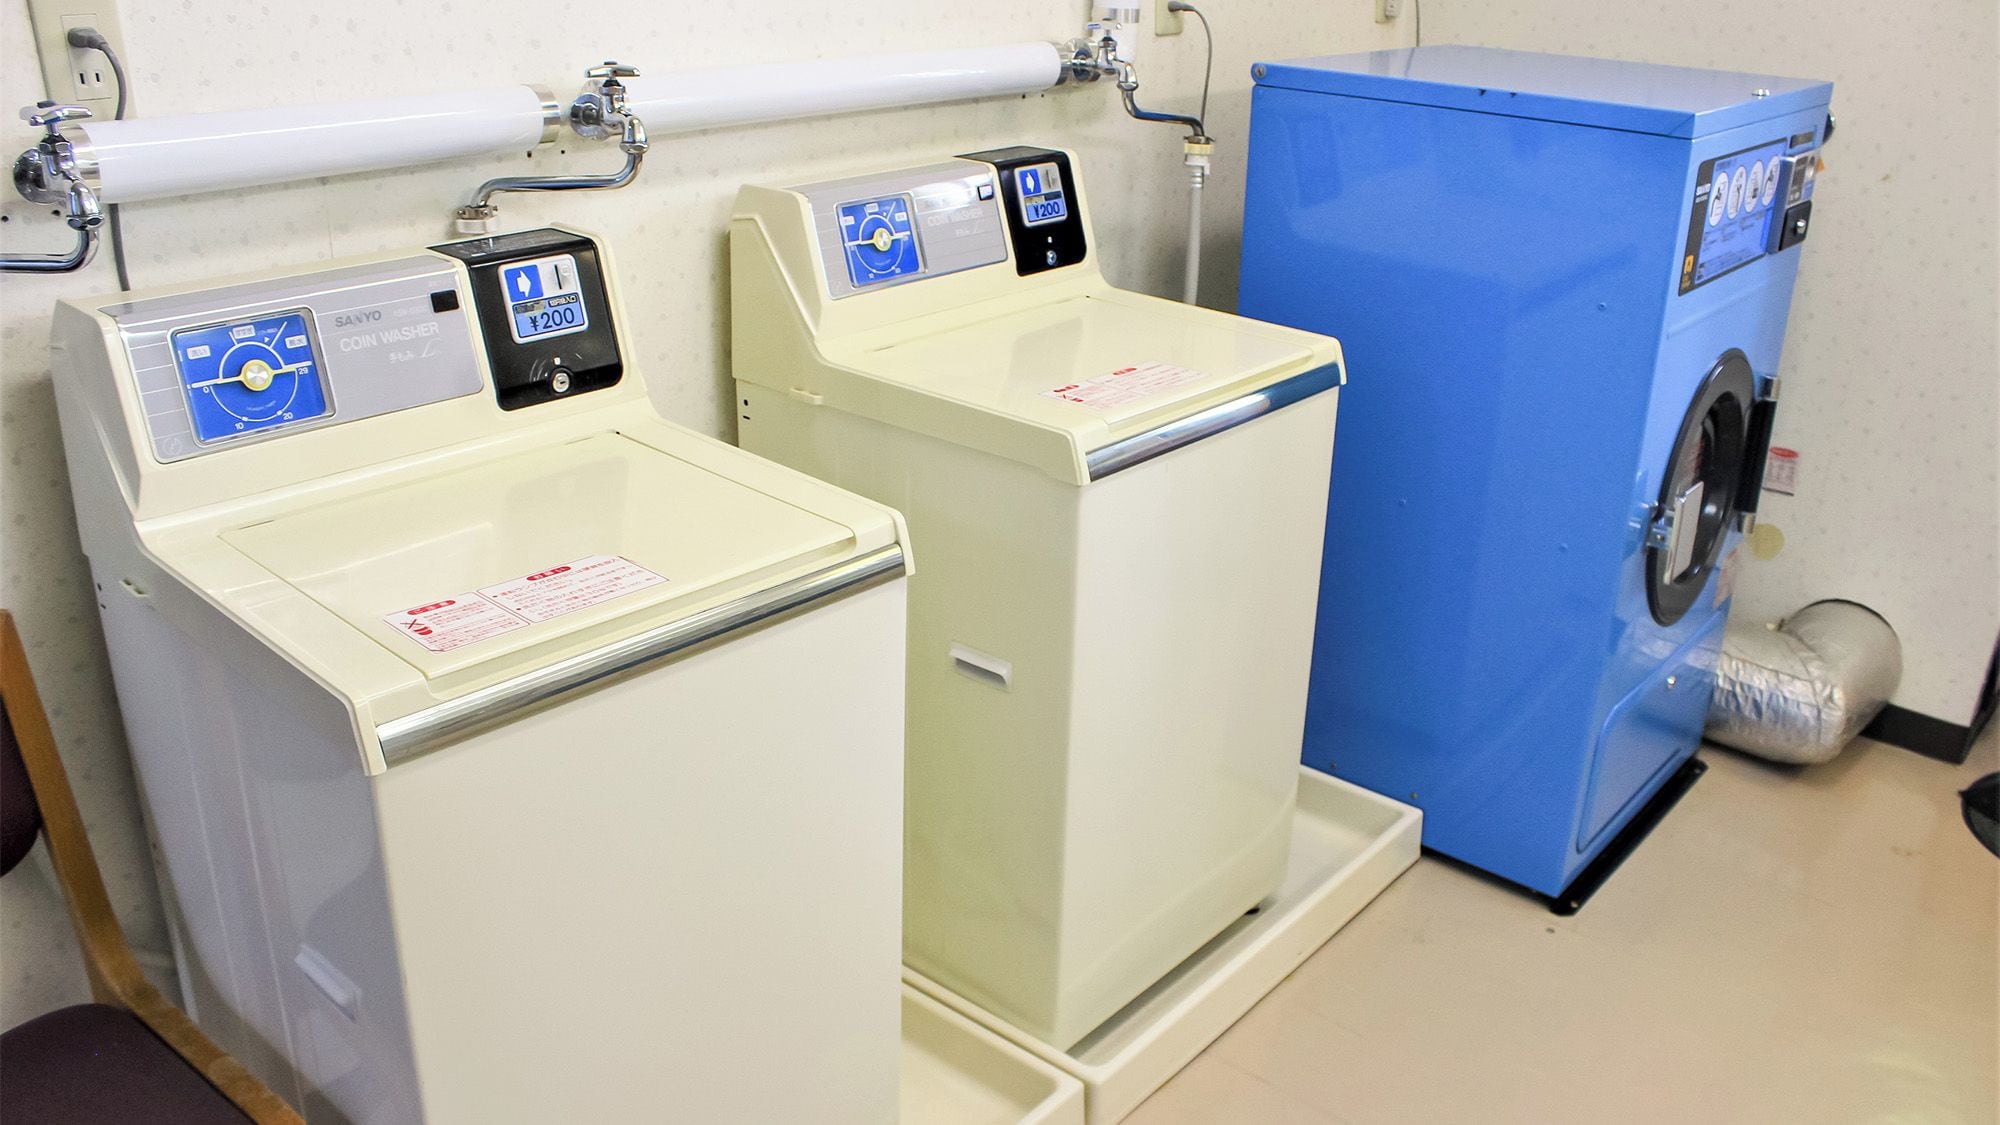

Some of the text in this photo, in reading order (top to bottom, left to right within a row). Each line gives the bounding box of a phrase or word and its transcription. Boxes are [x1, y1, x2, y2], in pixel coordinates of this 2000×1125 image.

[529, 307, 575, 331] ¥200
[340, 333, 379, 353] COIN
[379, 321, 440, 344] WASHER
[298, 367, 309, 375] 29
[282, 412, 294, 420] 20
[234, 422, 245, 430] 10
